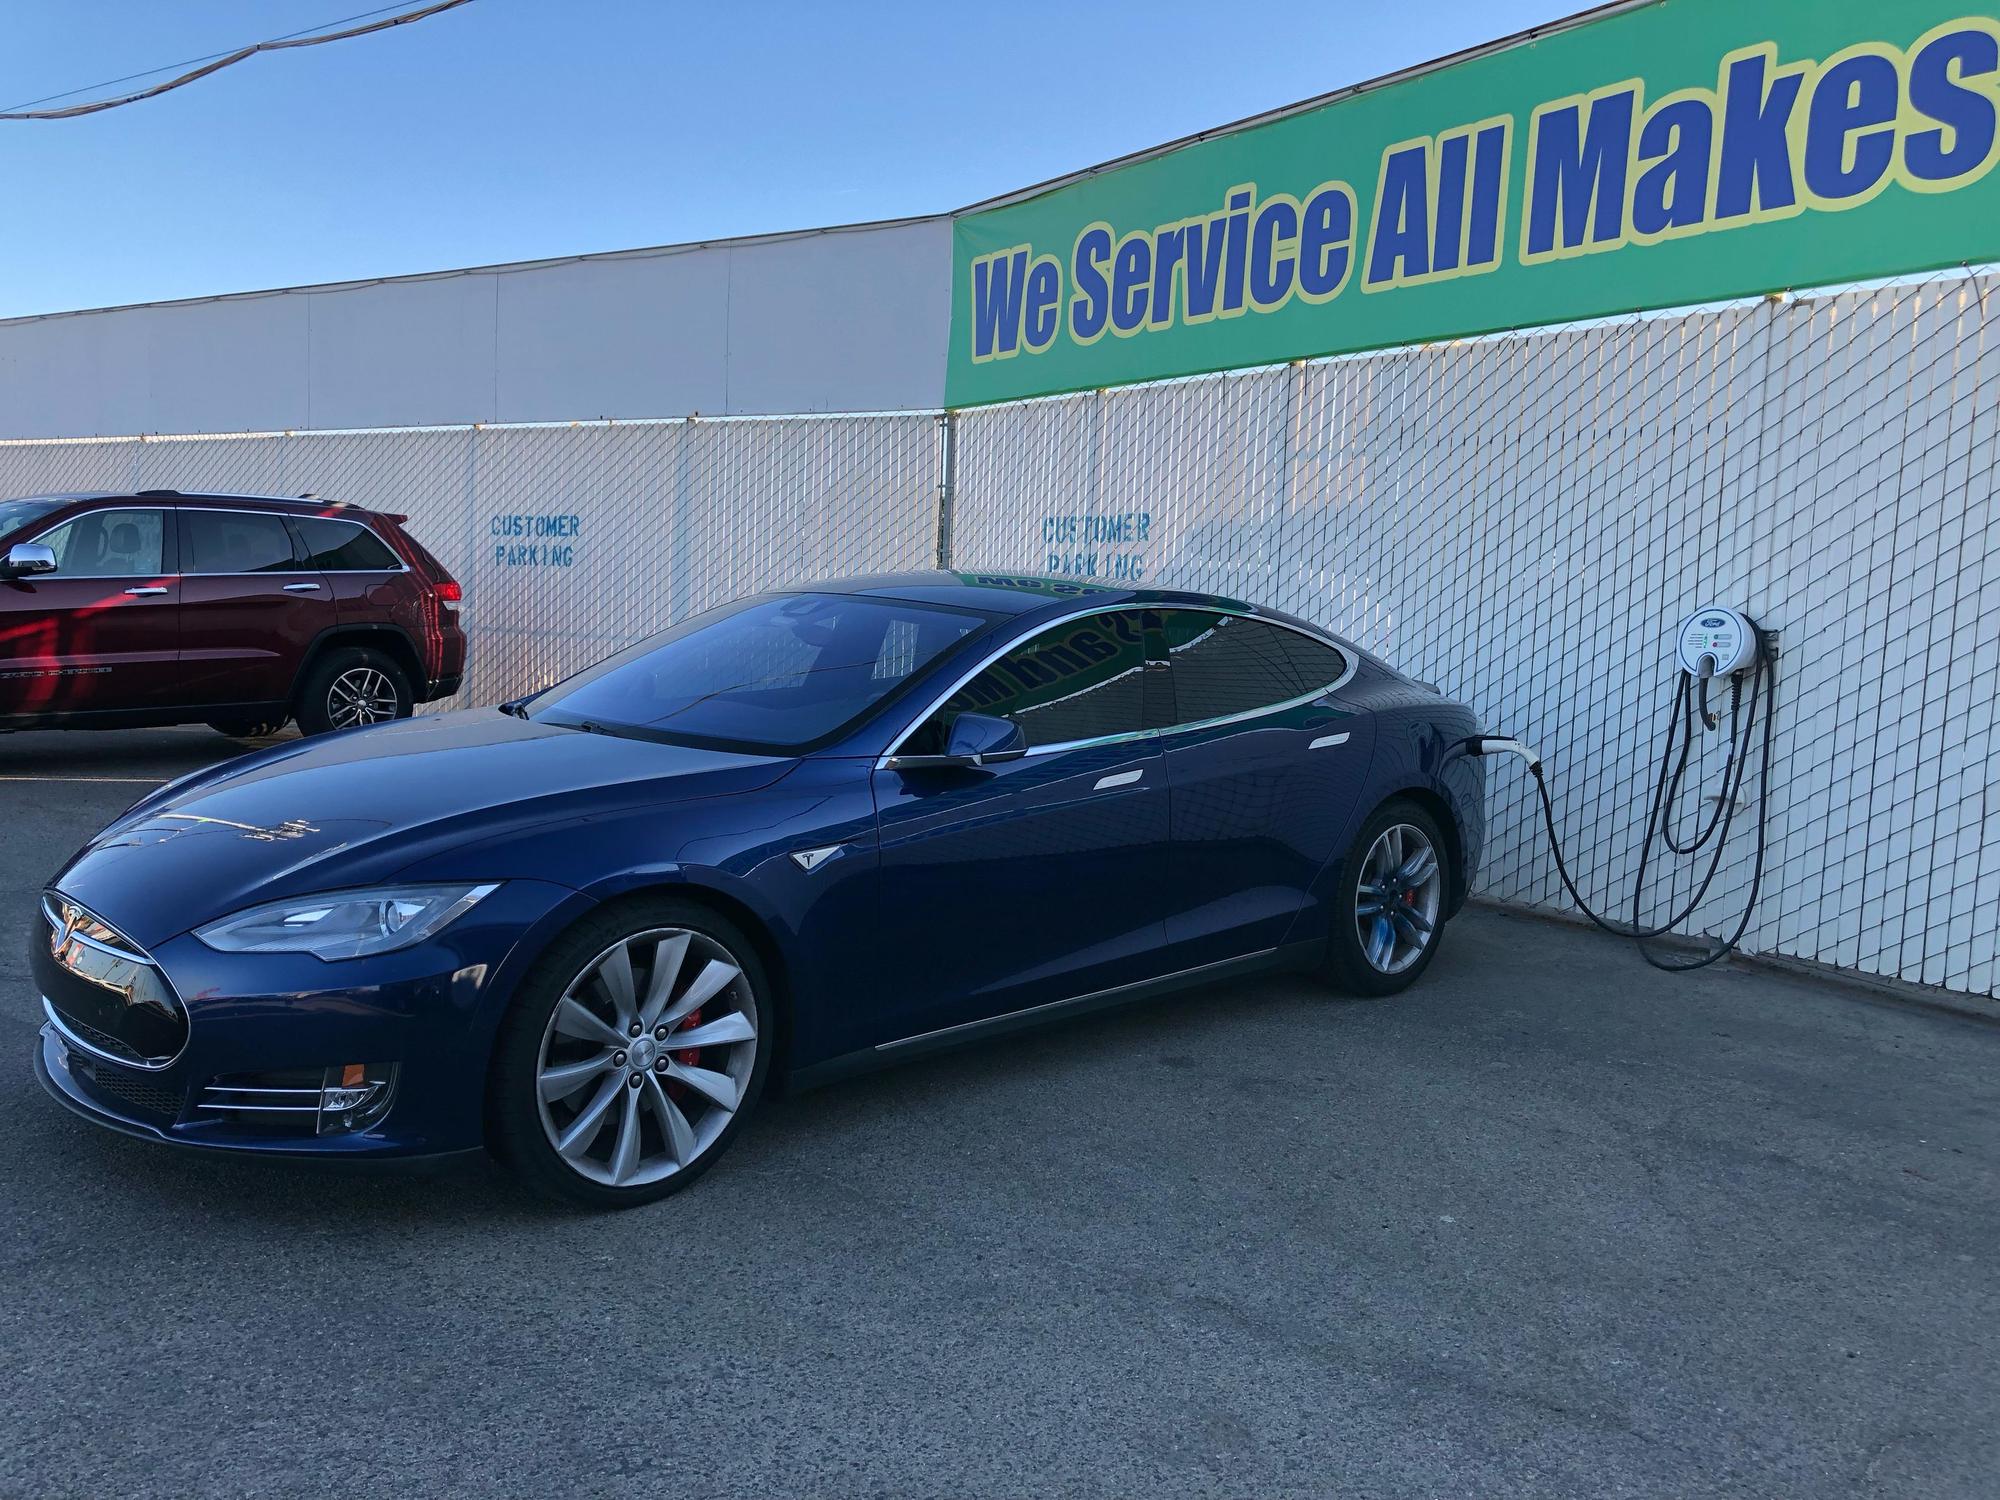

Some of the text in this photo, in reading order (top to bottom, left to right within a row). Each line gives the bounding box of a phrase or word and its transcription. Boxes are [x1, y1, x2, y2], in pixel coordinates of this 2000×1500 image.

[974, 30, 1999, 358] We Service All Makes
[491, 515, 580, 537] CUSTOMER
[1042, 512, 1150, 543] CUSTOMER
[495, 545, 573, 567] PARKING
[1048, 553, 1143, 581] PARKING
